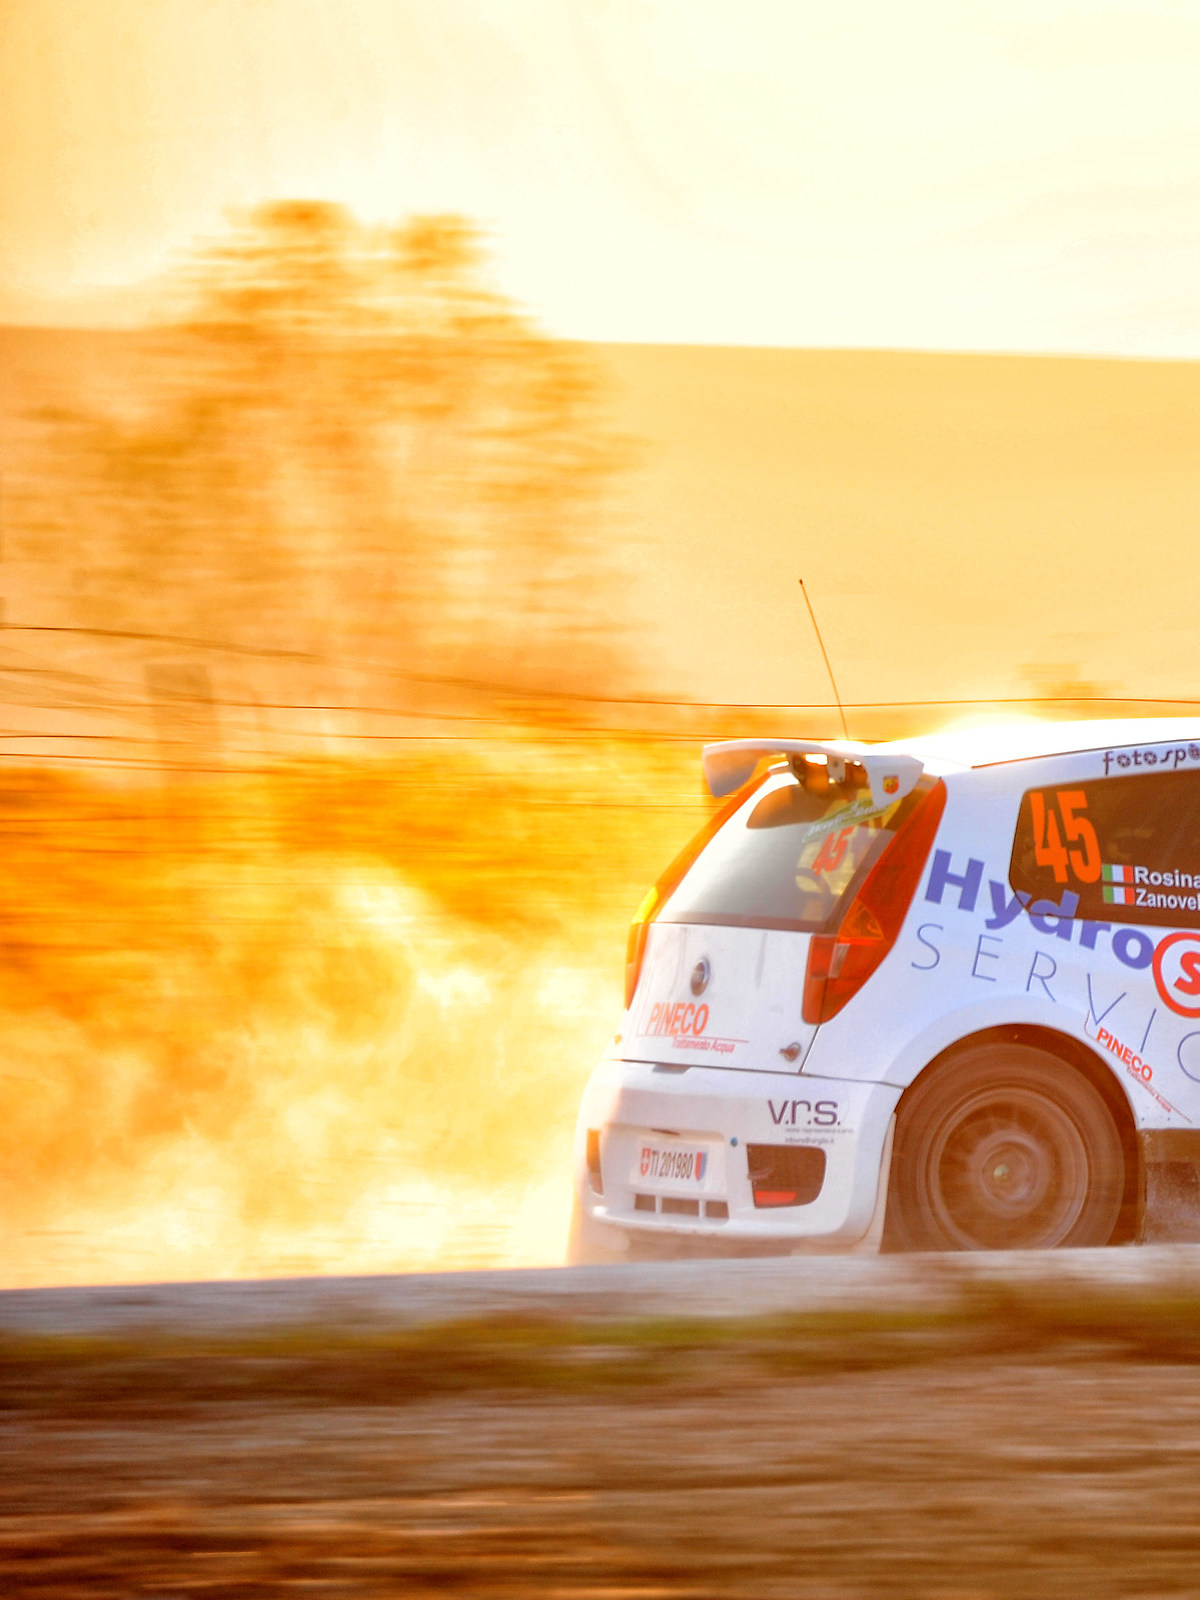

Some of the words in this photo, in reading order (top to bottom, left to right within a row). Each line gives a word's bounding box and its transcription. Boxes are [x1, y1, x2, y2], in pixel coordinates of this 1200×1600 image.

[811, 825, 855, 876] 45
[1030, 790, 1101, 884] 45
[645, 1002, 709, 1036] PINECO
[1096, 1027, 1153, 1082] PINECO
[660, 1151, 694, 1180] 201980
